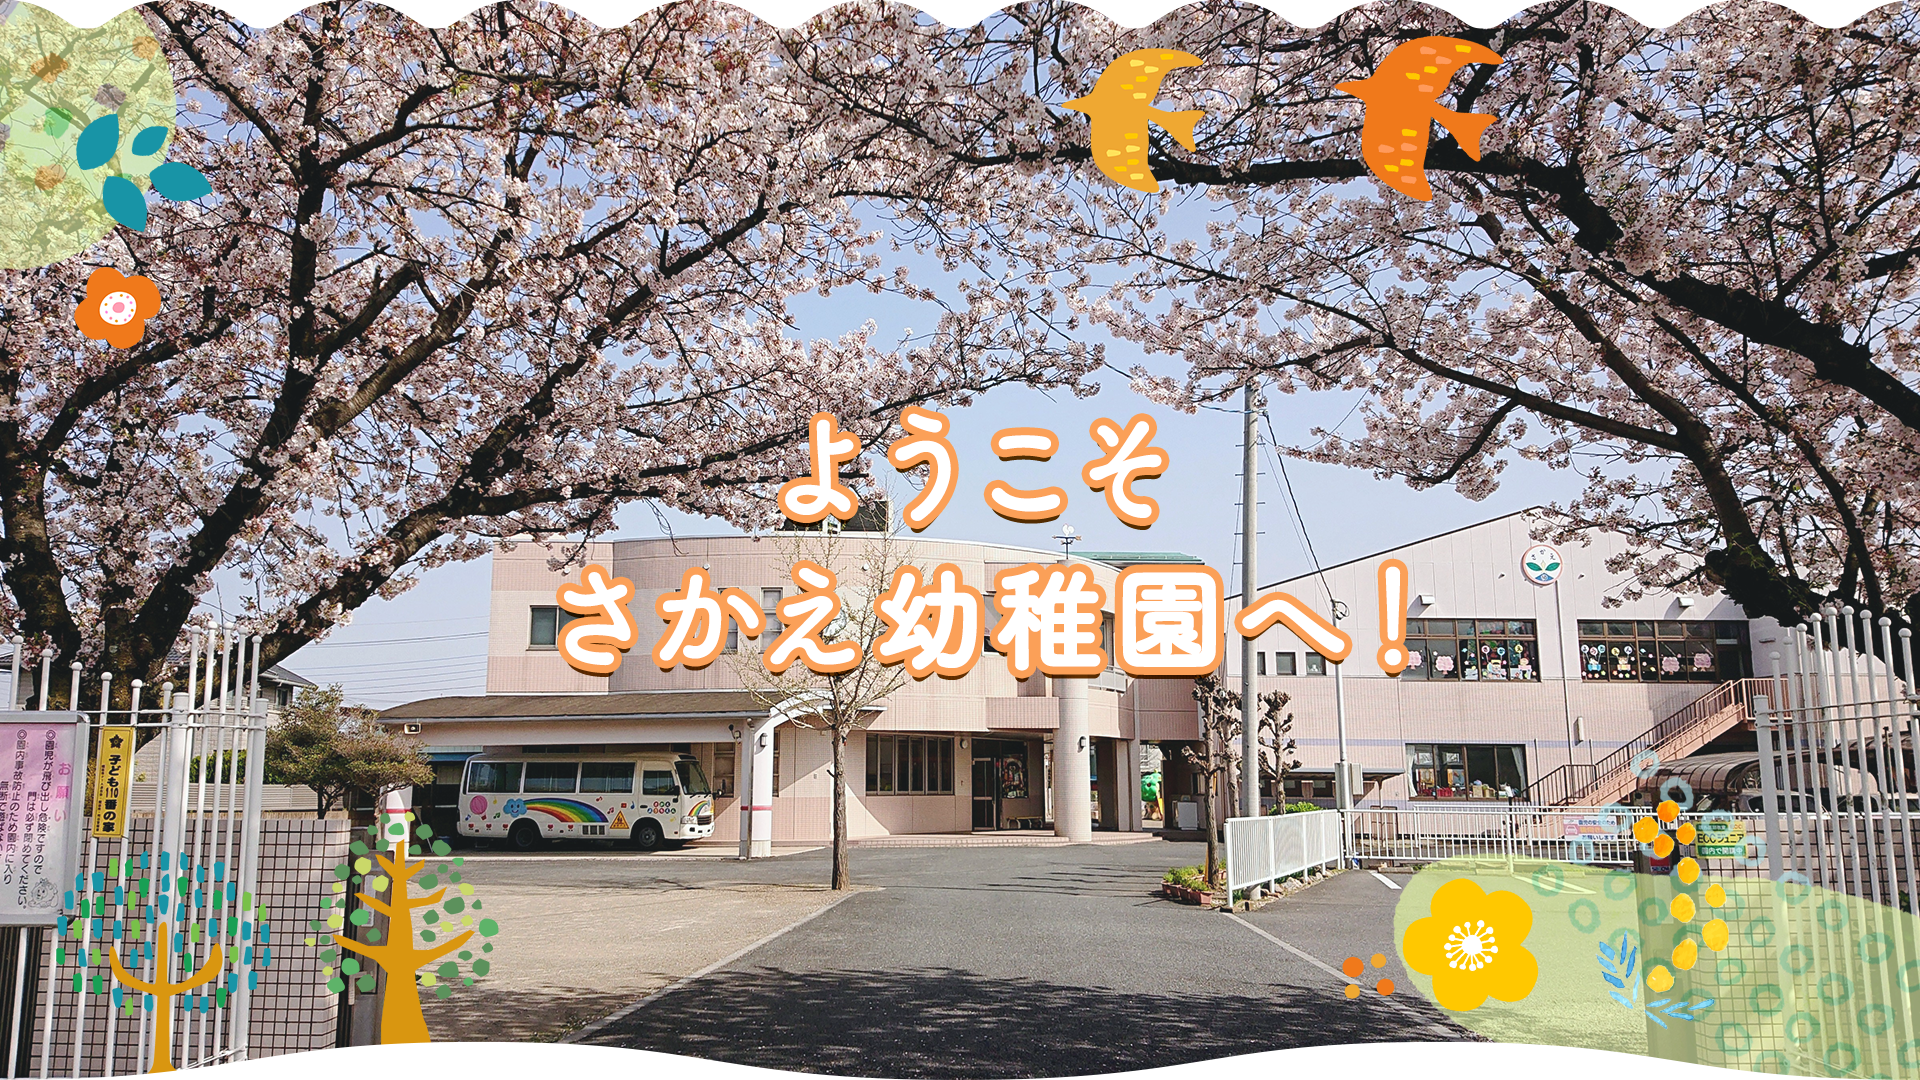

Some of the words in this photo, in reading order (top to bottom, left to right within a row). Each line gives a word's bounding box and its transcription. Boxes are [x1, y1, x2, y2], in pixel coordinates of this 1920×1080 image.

[54, 762, 71, 822] お願い
[102, 754, 122, 833] 子ども110番の家
[1697, 833, 1744, 844] ECCジュニア
